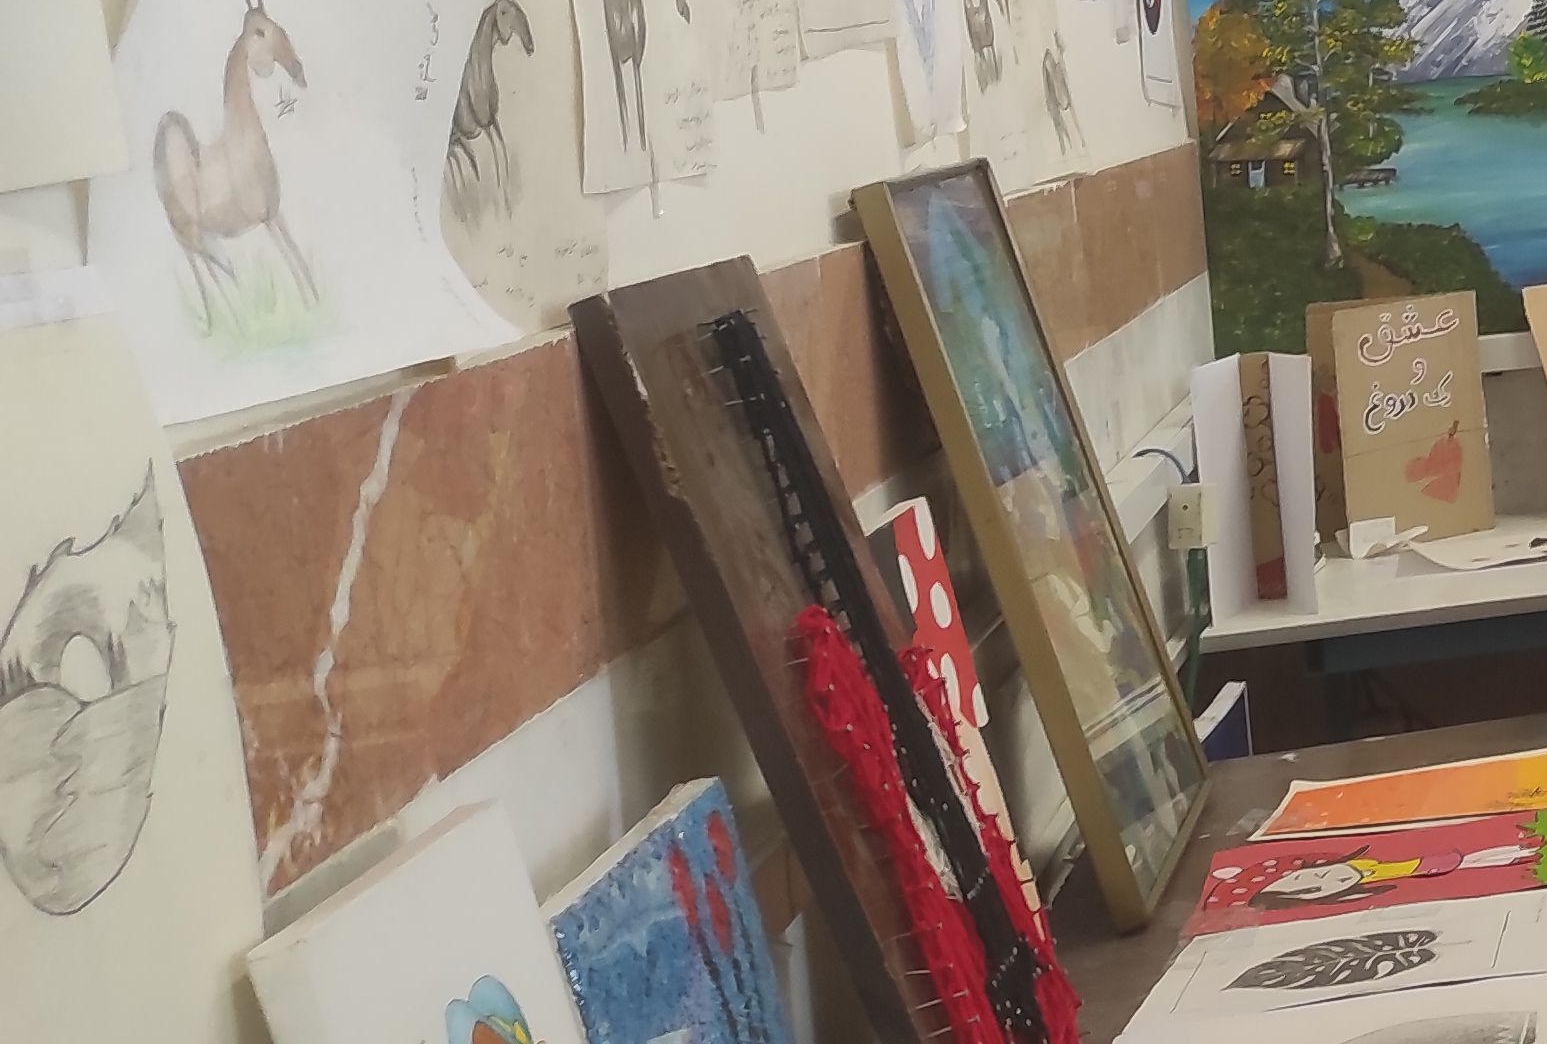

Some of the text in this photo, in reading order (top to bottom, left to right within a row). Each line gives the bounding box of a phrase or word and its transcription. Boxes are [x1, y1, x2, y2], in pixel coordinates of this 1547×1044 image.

[1358, 304, 1460, 367] عشق
[1410, 357, 1428, 386] و
[1363, 380, 1418, 436] دروغ
